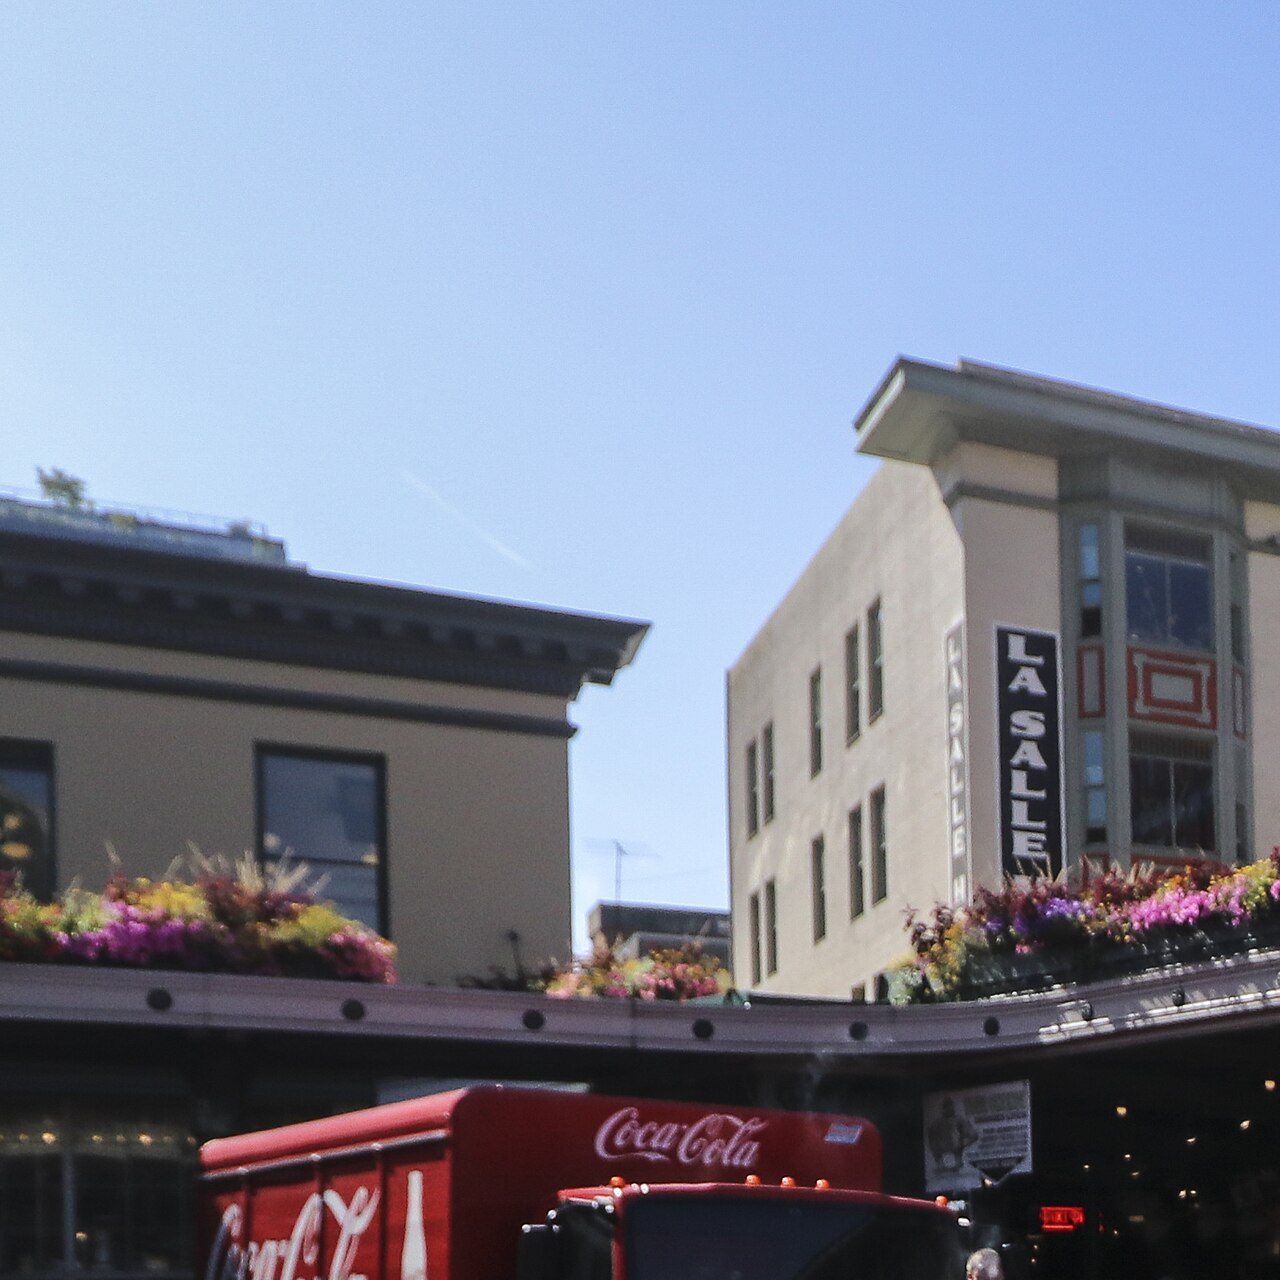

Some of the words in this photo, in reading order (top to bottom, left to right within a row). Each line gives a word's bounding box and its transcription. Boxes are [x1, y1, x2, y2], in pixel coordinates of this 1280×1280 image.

[1007, 633, 1047, 697] LA
[1009, 709, 1048, 860] SALLE
[595, 1106, 769, 1169] Coca-Cola
